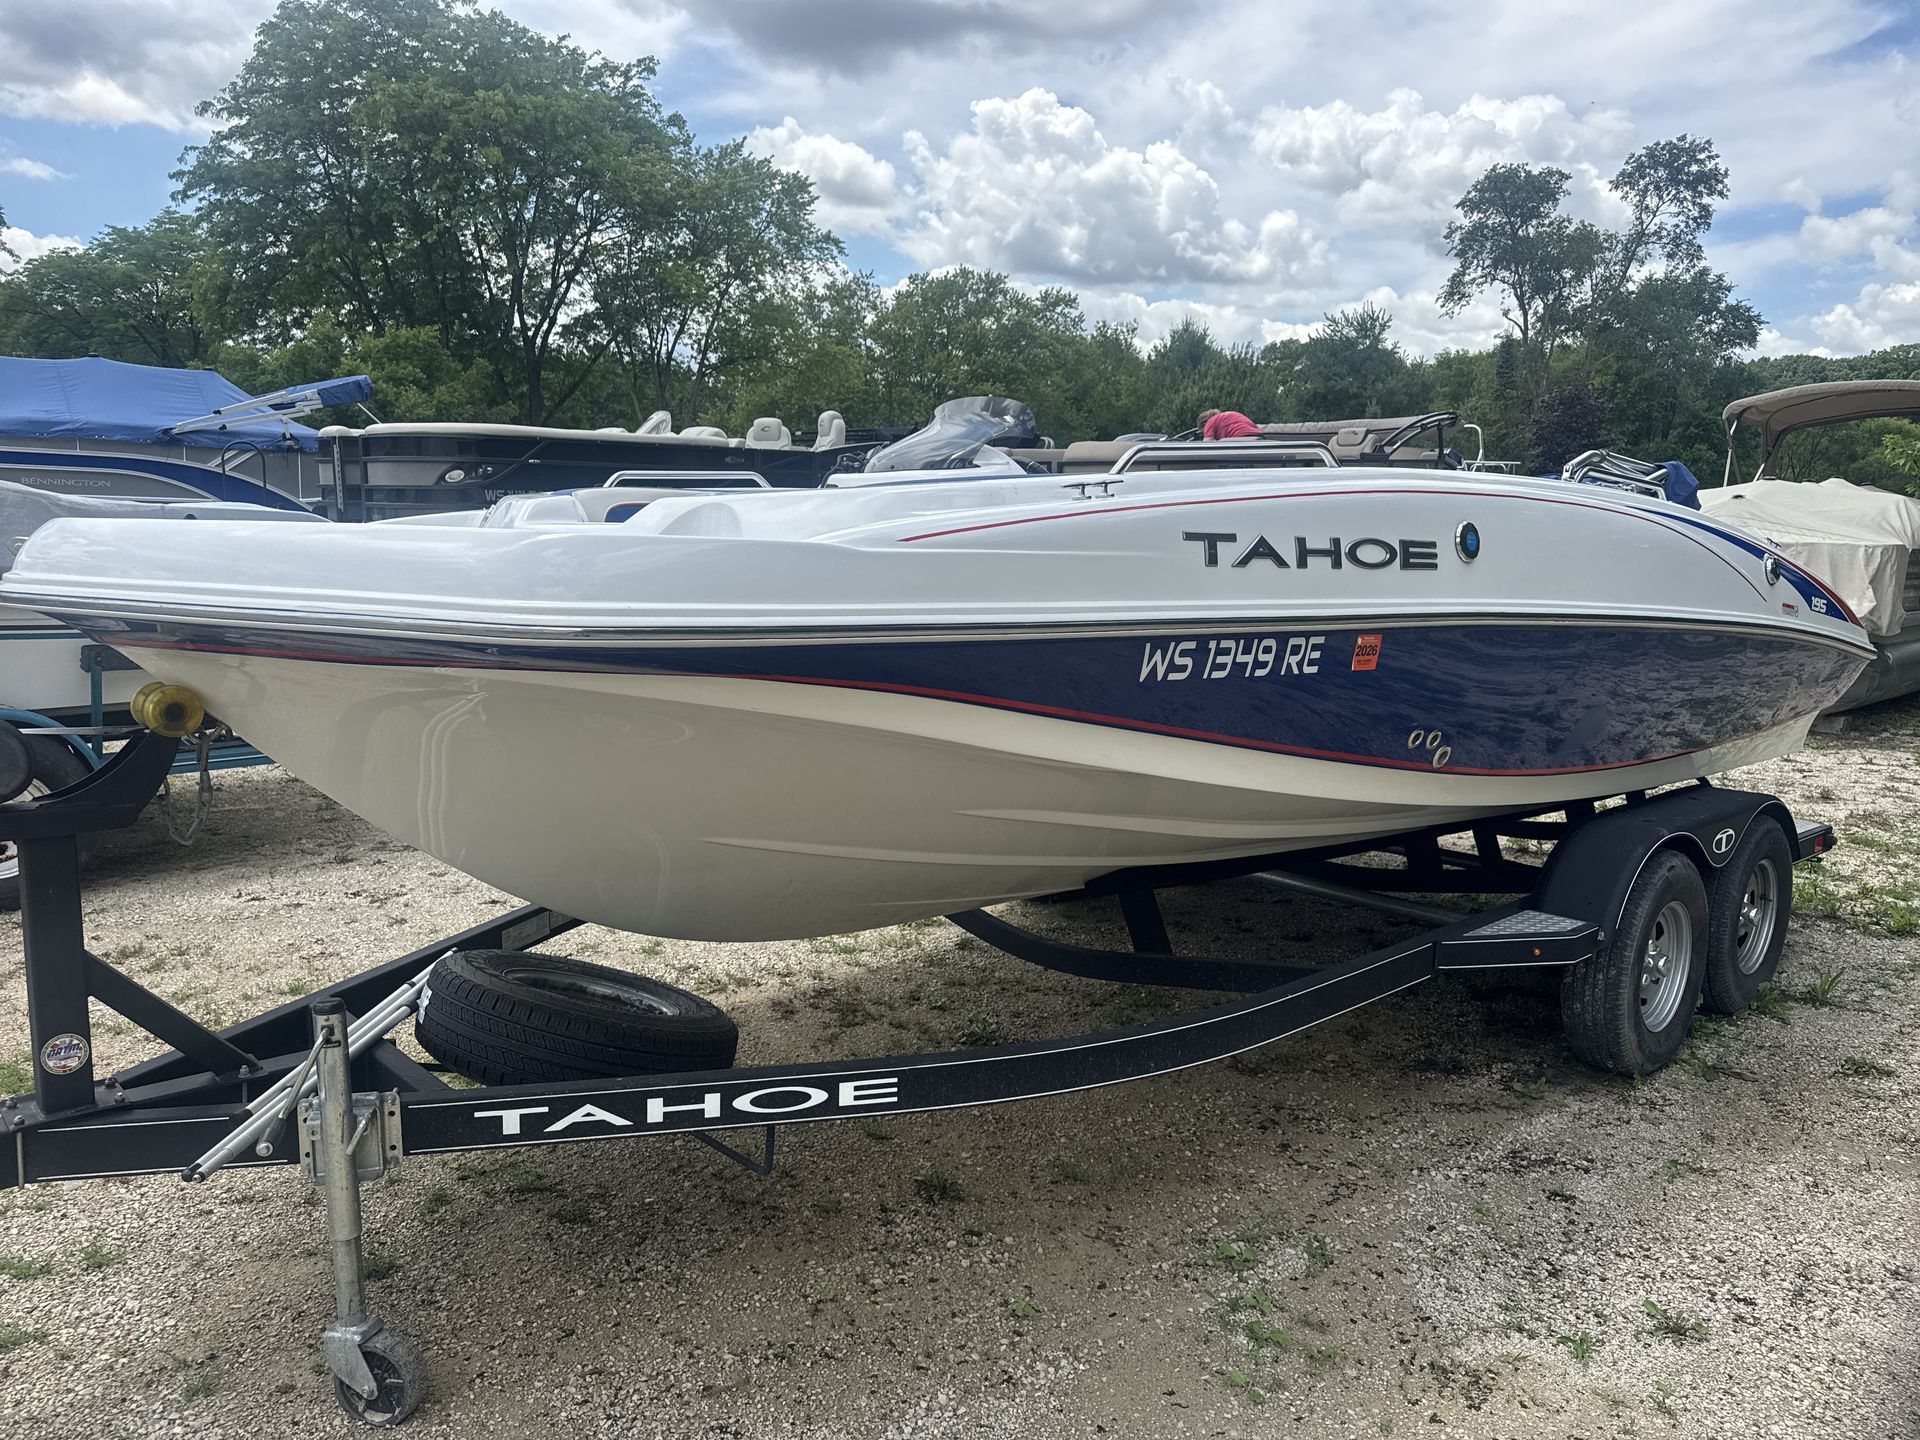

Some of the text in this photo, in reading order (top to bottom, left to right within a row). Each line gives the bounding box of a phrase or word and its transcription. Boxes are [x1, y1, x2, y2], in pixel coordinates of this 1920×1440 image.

[21, 477, 111, 487] BENNINGTON
[485, 489, 504, 501] WS
[1182, 531, 1438, 570] TAHOE
[1811, 596, 1827, 613] 195
[1139, 636, 1326, 682] WS 1349 RE
[1355, 645, 1378, 656] 2026
[473, 1077, 898, 1135] TAHOE
